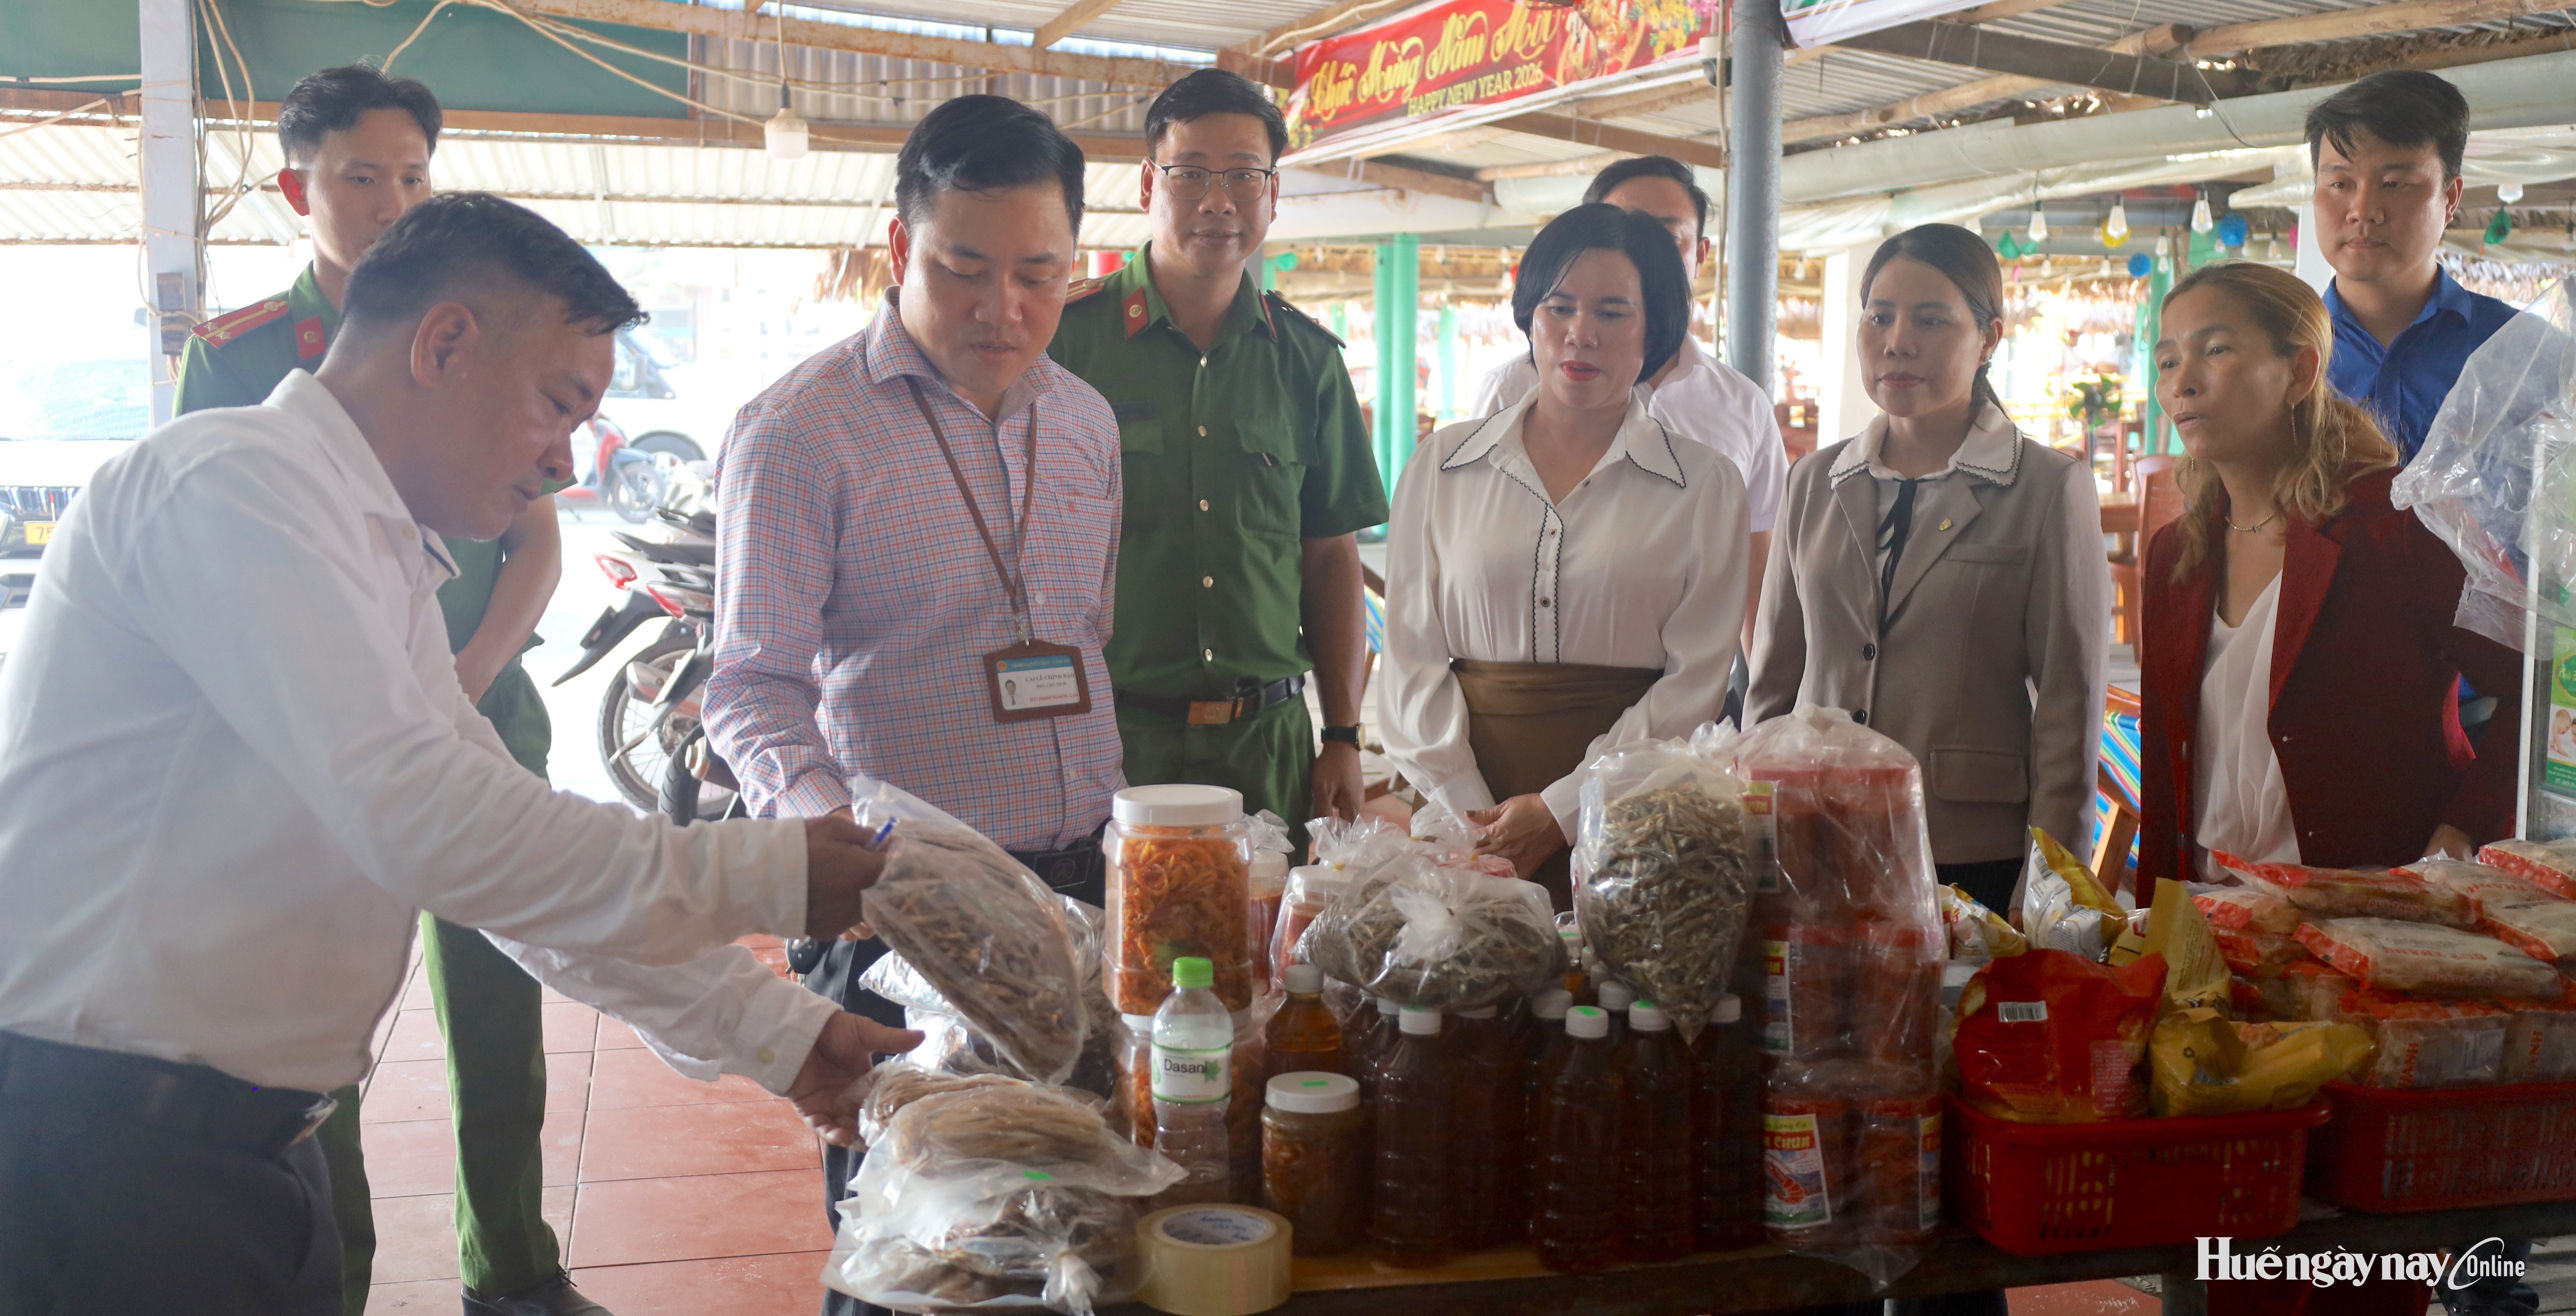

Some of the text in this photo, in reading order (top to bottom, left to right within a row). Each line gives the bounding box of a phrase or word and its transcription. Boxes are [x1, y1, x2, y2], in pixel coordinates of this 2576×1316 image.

[1357, 36, 1424, 104] Mừng
[1425, 10, 1489, 80] Năm
[1407, 61, 1544, 116] HAPPY NEW YEAR 2026
